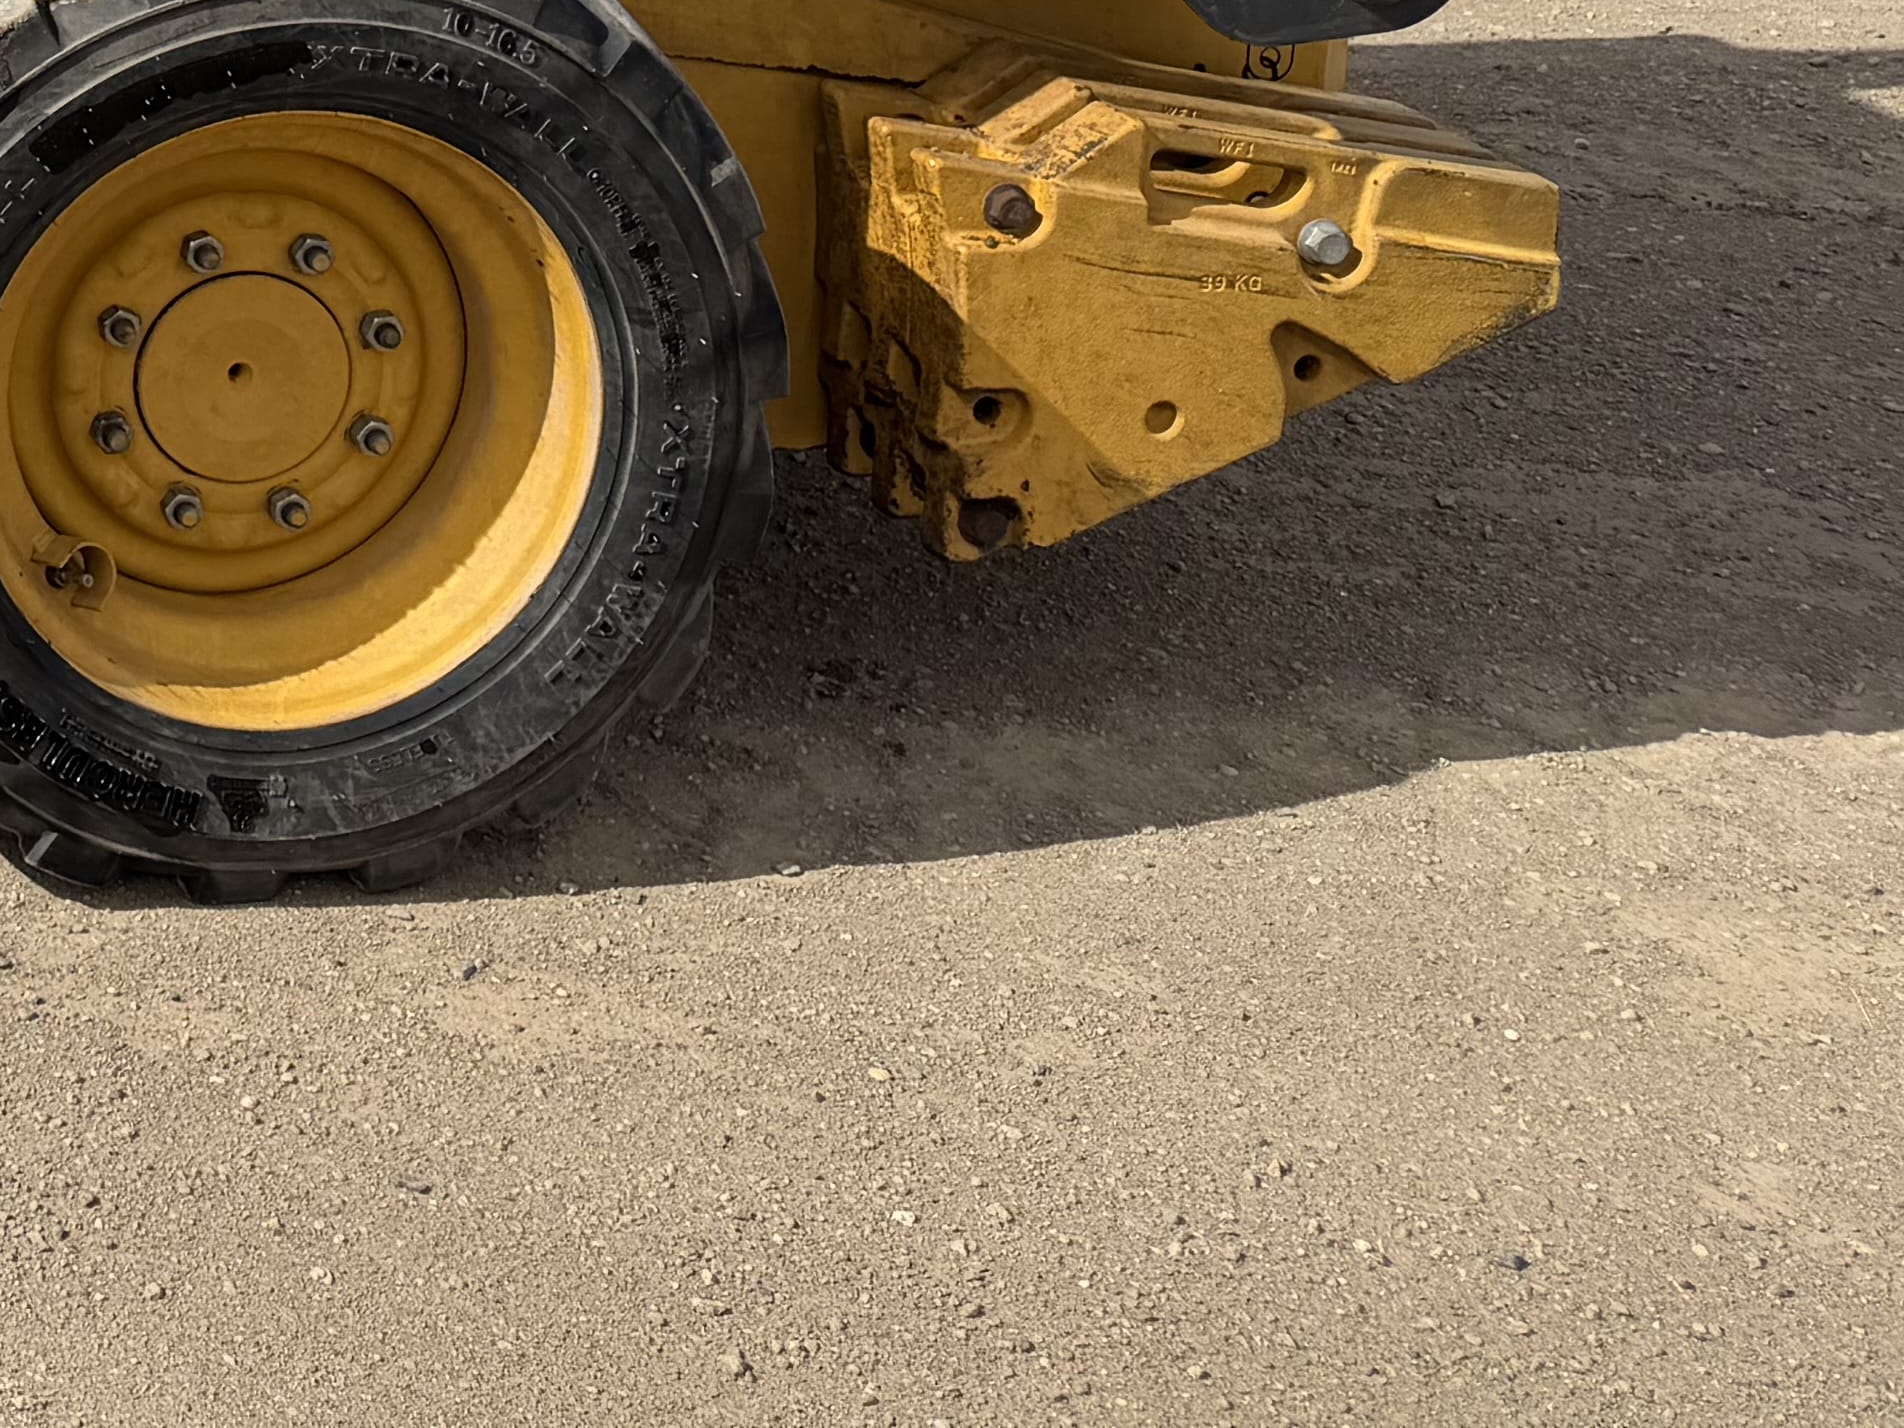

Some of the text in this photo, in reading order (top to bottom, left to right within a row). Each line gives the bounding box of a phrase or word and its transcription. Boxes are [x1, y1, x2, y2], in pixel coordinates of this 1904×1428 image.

[441, 6, 539, 65] 10-16.5
[307, 43, 585, 174] XTRA-WALL
[544, 420, 691, 682] XTRA-WALL
